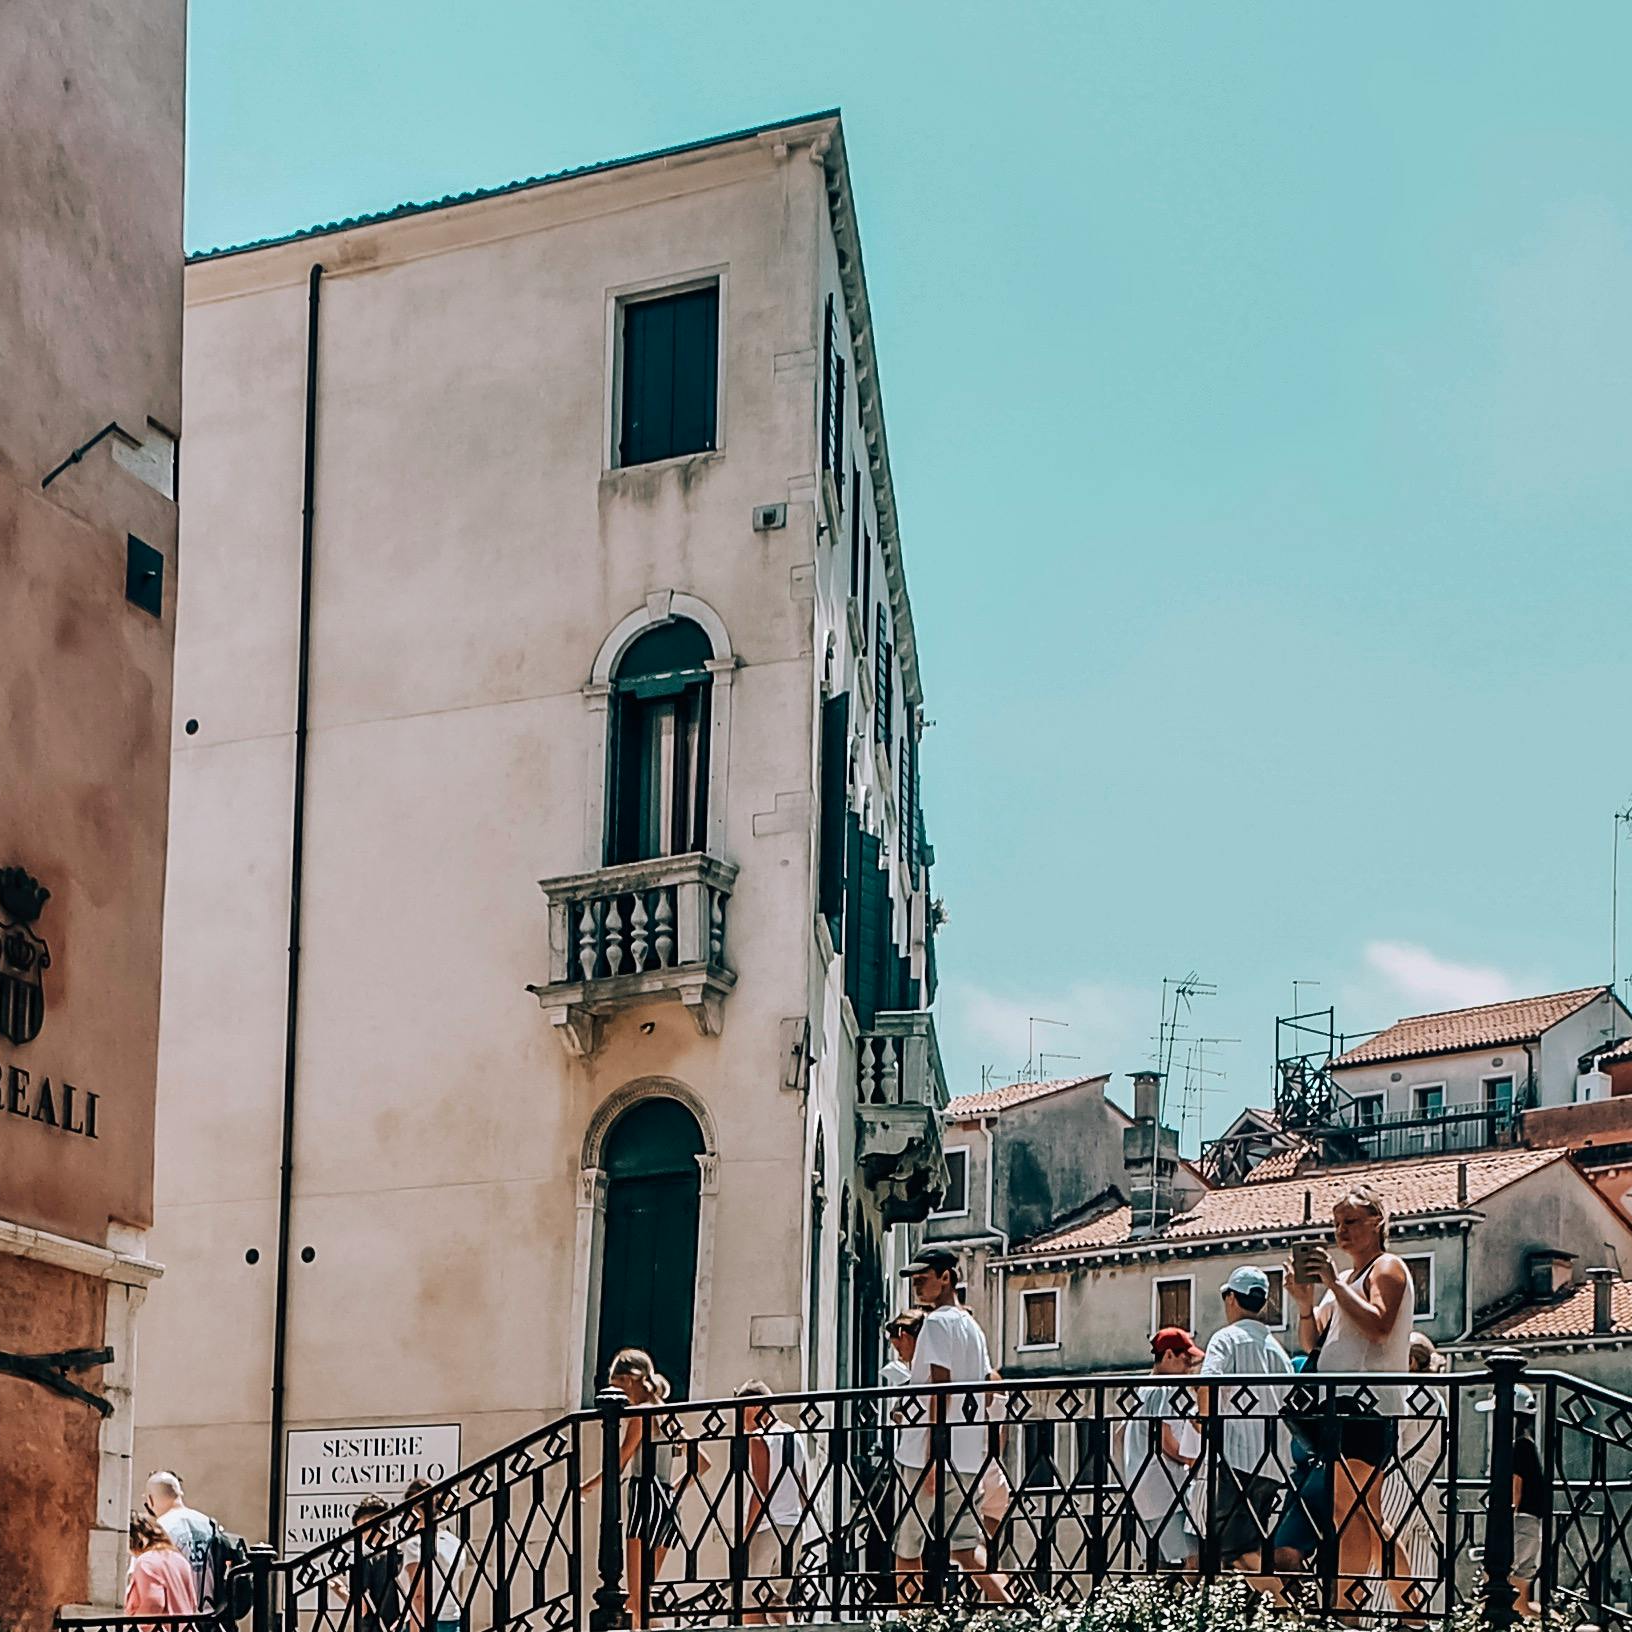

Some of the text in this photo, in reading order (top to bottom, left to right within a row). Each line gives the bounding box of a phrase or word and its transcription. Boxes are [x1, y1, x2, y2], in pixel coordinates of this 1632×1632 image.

[322, 1436, 423, 1458] SESTIERE
[301, 1463, 445, 1485] DI CASTELLO
[301, 1527, 352, 1542] MARI
